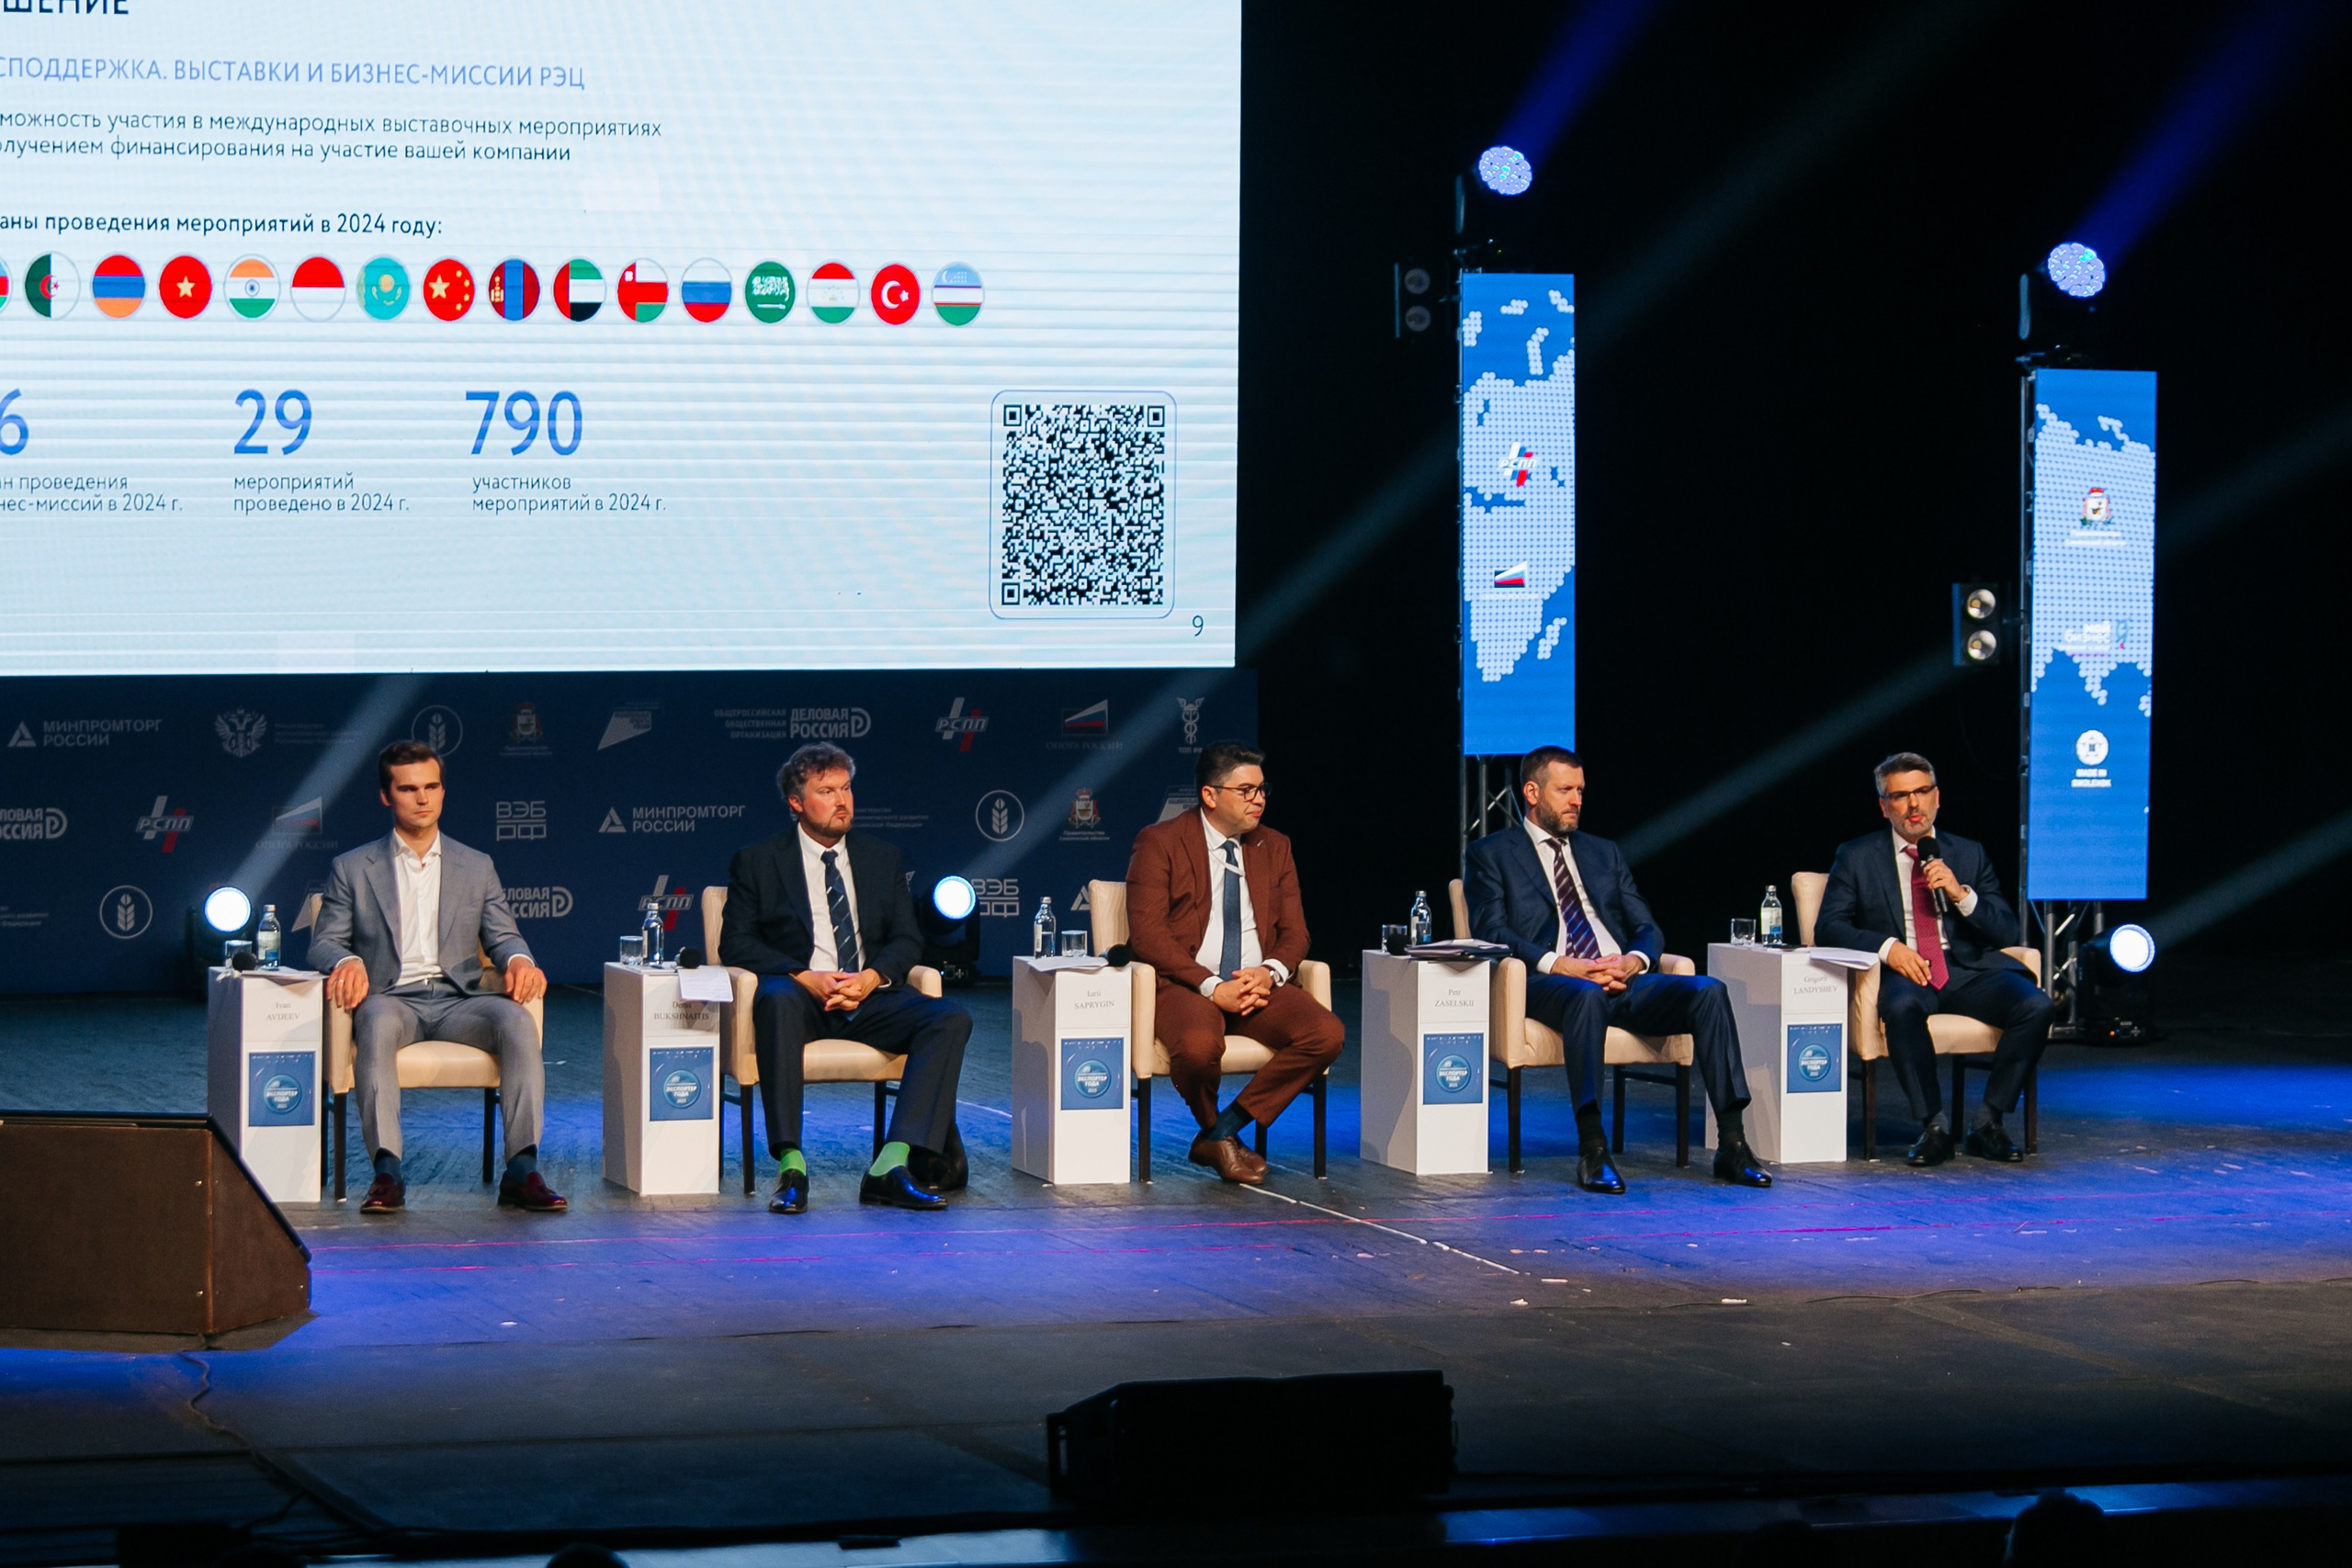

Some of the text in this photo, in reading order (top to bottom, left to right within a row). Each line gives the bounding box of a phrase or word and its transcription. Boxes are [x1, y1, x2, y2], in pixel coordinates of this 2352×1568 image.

[175, 60, 299, 82] ВЫСТАВКИ
[308, 62, 322, 83] И
[331, 63, 531, 86] БИЗНЕС-МИССИИ
[540, 66, 585, 90] РЭЦ
[0, 113, 661, 141] можность участия в международных выставочных мероприятиях
[0, 134, 570, 163] лучением финансирования на участие вашей компании
[0, 212, 442, 239] аны проведения мероприятий в 2024 году:
[0, 389, 29, 456] 6
[233, 389, 312, 456] 29
[465, 390, 582, 456] 790
[1498, 458, 1538, 469] РСПП
[19, 477, 129, 494] проведения
[234, 471, 355, 494] мероприятий
[473, 477, 571, 494] участников
[108, 499, 117, 511] в
[123, 493, 166, 511] 2024
[172, 499, 183, 511] г.
[233, 493, 410, 515] проведено в 2024 г.
[472, 492, 667, 515] мероприятий в 2024 г.
[1192, 615, 1204, 637] 9
[790, 707, 849, 721] ДЕЛОВАЯ
[43, 719, 163, 733] МИНПРОМТОРГ
[790, 722, 849, 739] РОССИЯ
[937, 718, 988, 731] РСПП
[43, 734, 109, 747] РОССИИ
[496, 801, 547, 818] ВЭБ
[632, 806, 746, 818] МИНПРОМТОРГ
[0, 823, 43, 840] ССИЯ
[139, 817, 193, 830] РСПП
[632, 820, 695, 832] РОССИИ
[496, 823, 547, 842] РФ
[503, 886, 549, 901] ЛОВАЯ
[971, 879, 1019, 896] ВЭБ
[1793, 985, 1838, 995] LANDYSHEV
[1074, 999, 1114, 1010] SAPRYGIN
[1434, 999, 1475, 1008] ZASELSKII
[266, 1012, 300, 1021] AVDEEV
